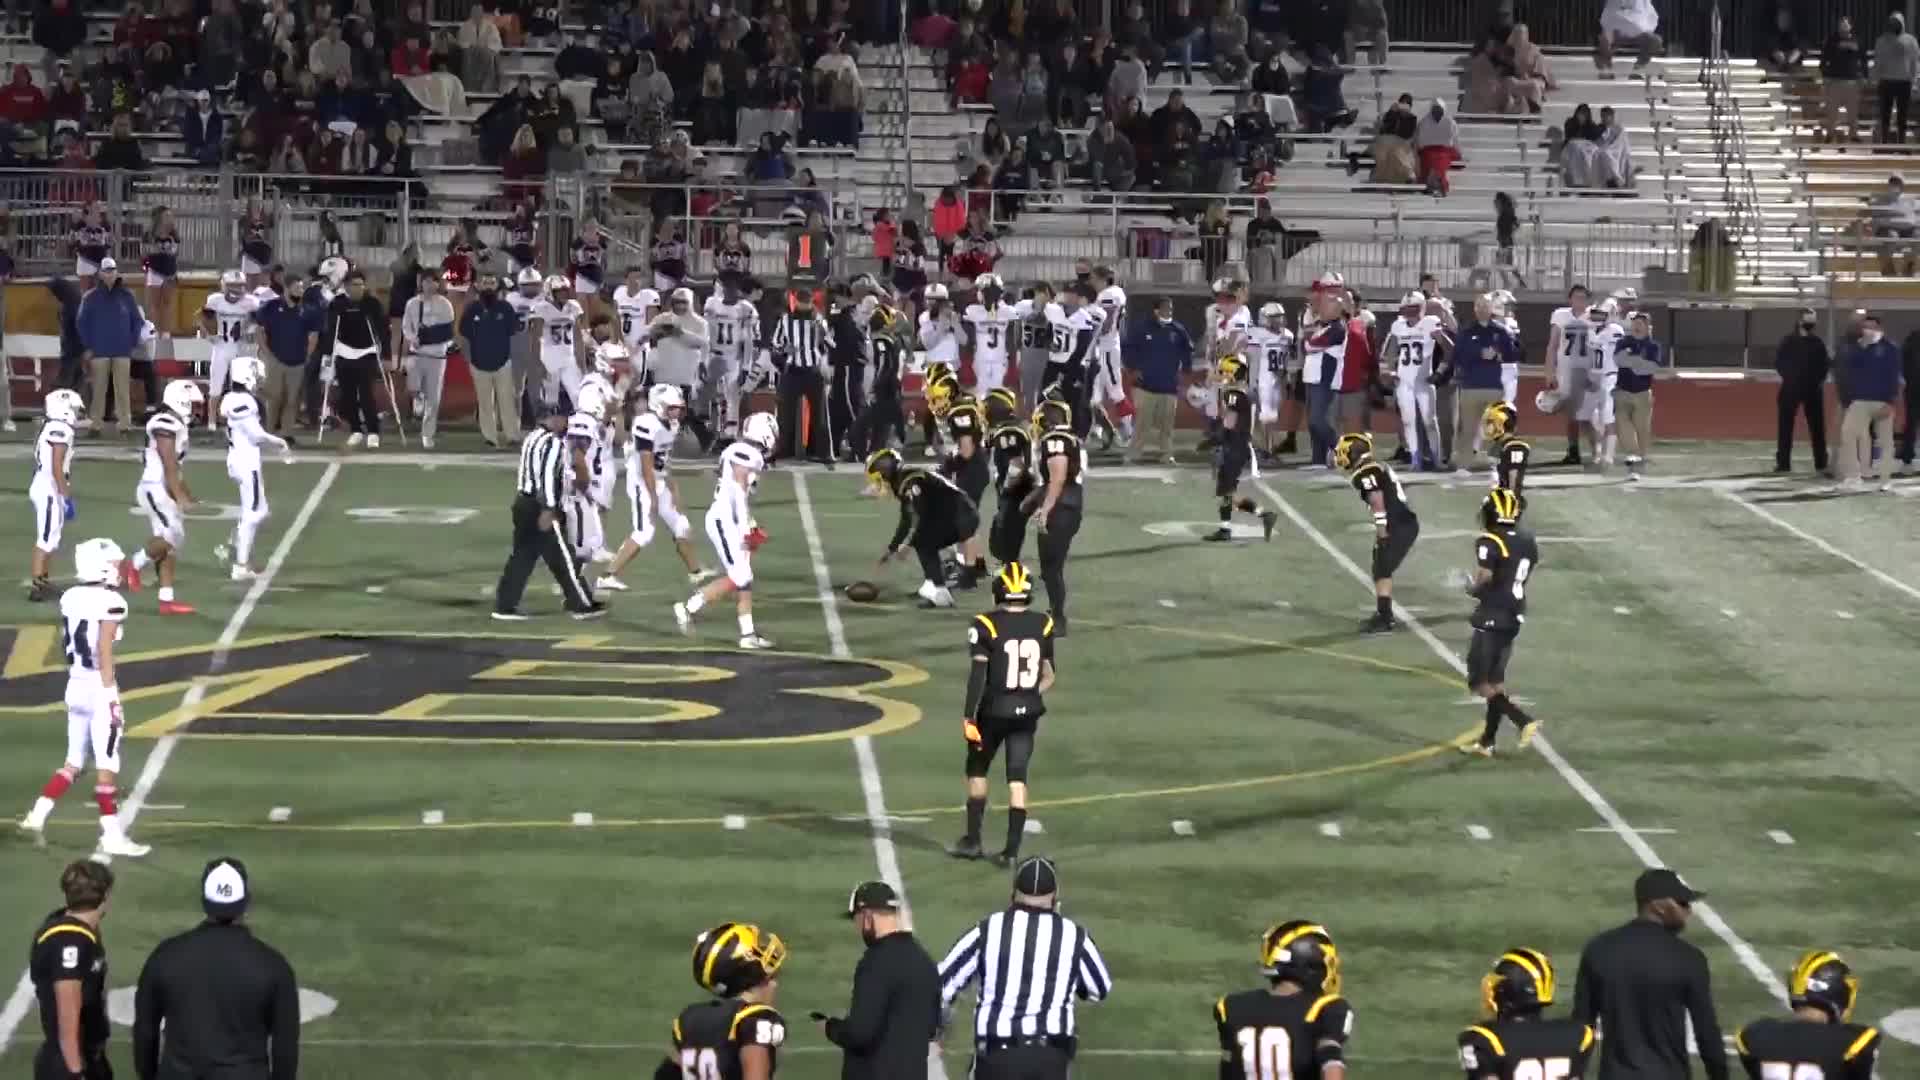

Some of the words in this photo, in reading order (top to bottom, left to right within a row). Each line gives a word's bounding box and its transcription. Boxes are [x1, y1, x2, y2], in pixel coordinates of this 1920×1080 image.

[799, 234, 811, 268] 1
[718, 322, 734, 345] 11
[987, 333, 999, 348] 3
[1566, 333, 1588, 357] 71
[1401, 341, 1424, 366] 33
[1003, 638, 1040, 689] 13
[62, 946, 78, 968] 9
[1236, 1026, 1294, 1080] 10
